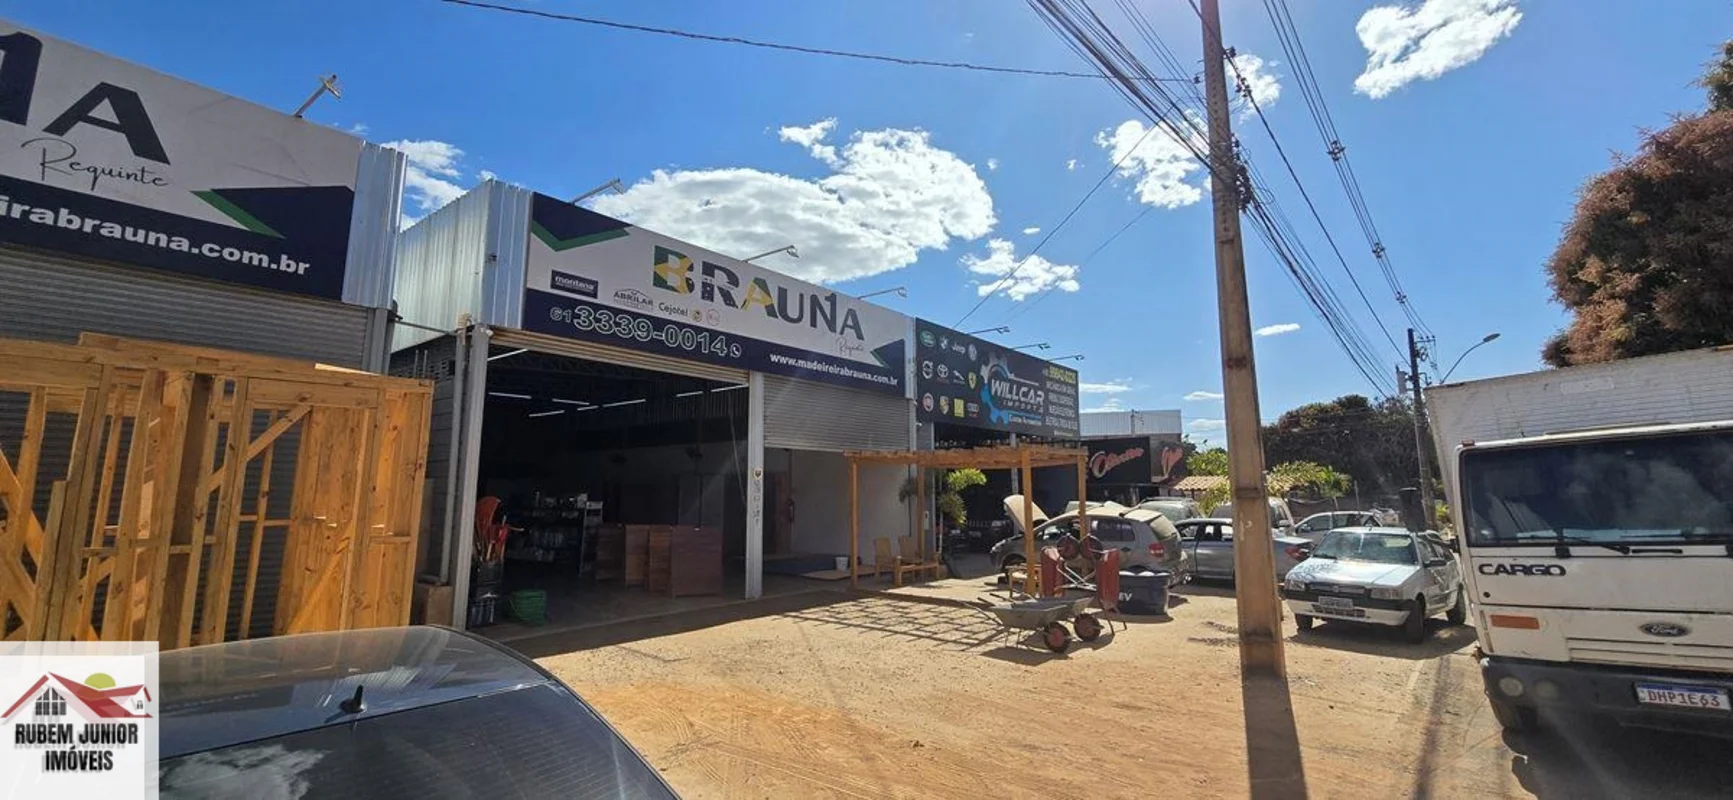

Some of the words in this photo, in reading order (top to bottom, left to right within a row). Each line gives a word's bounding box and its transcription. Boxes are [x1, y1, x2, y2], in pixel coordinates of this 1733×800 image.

[21, 138, 170, 191] Requinte
[652, 245, 865, 341] BRAUNA
[658, 303, 688, 317] Cejotel
[550, 307, 572, 323] 61
[573, 305, 727, 356] 3339-0014
[769, 353, 899, 387] www.madeireirabrauna.com.br
[991, 378, 1045, 406] WILLCAR
[1478, 563, 1566, 577] CARGO
[1650, 625, 1679, 635] Ford
[1648, 690, 1721, 708] DHP1E63
